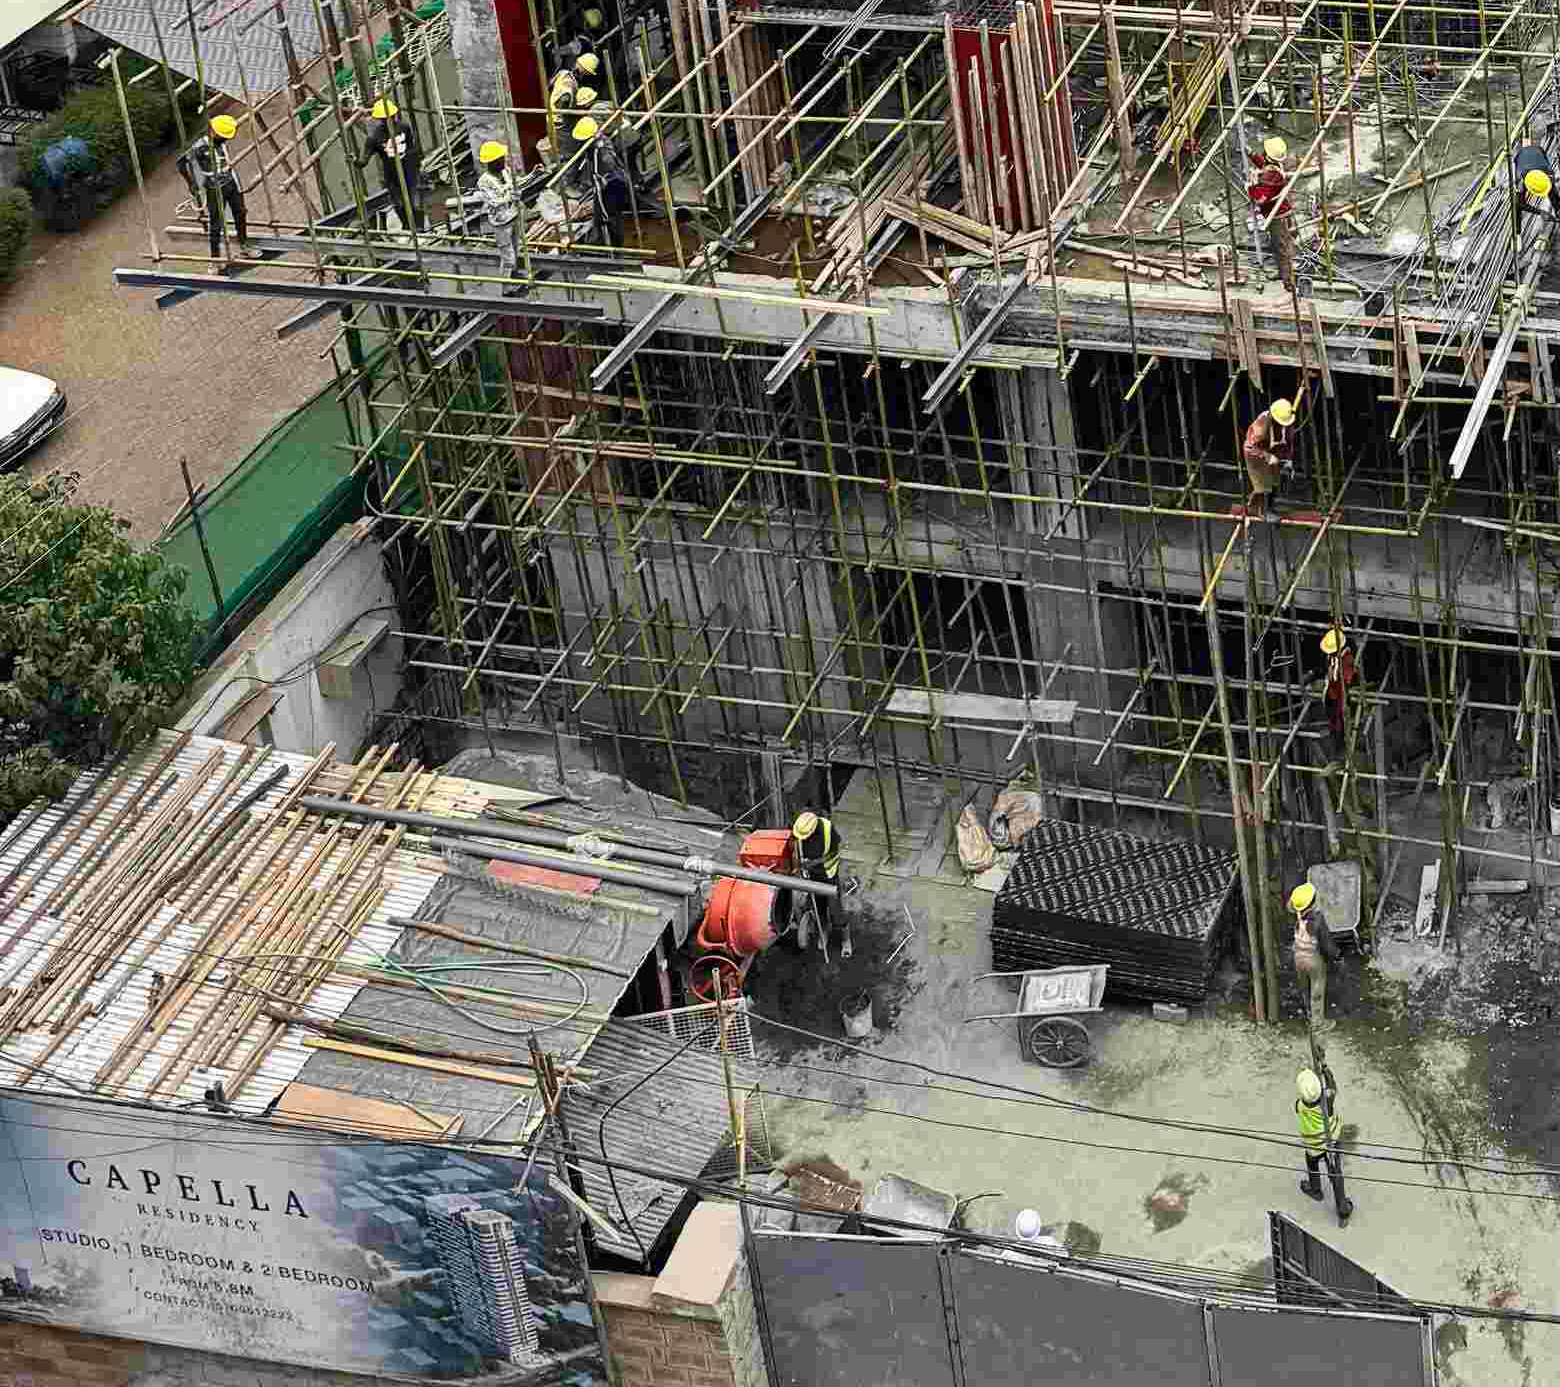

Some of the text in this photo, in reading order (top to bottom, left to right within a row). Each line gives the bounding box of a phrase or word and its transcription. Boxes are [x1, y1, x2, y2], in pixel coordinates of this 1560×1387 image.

[67, 1159, 309, 1219] CAPELLA
[137, 1203, 259, 1232] RESIDENCY
[40, 1228, 118, 1258] STUDIO,
[141, 1244, 235, 1272] BEDROOM
[243, 1261, 253, 1274] &
[261, 1265, 272, 1276] 2
[279, 1266, 375, 1293] BEDROOM
